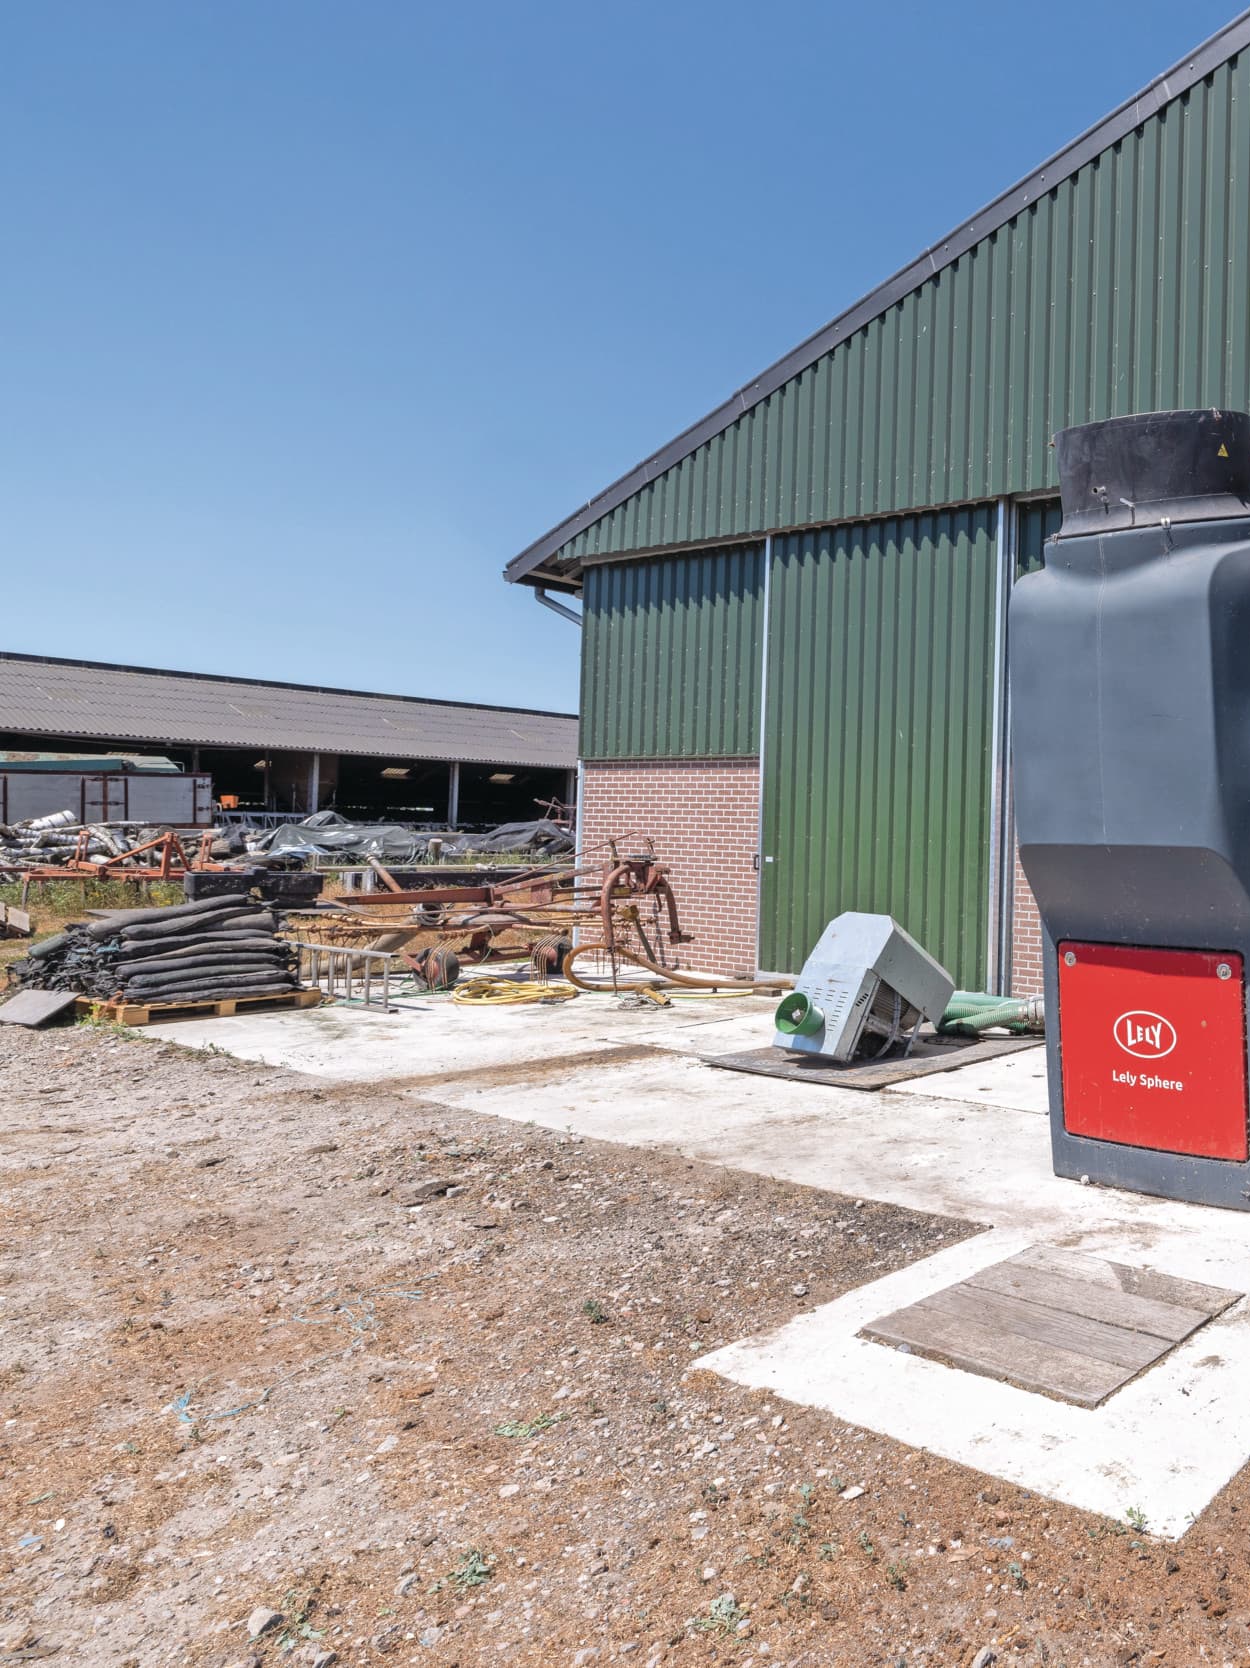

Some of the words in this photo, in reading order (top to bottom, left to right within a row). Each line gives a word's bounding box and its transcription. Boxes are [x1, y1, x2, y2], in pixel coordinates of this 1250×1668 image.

[1126, 1018, 1162, 1049] LELY
[1112, 1069, 1137, 1087] Lely
[1140, 1074, 1183, 1091] Sphere
